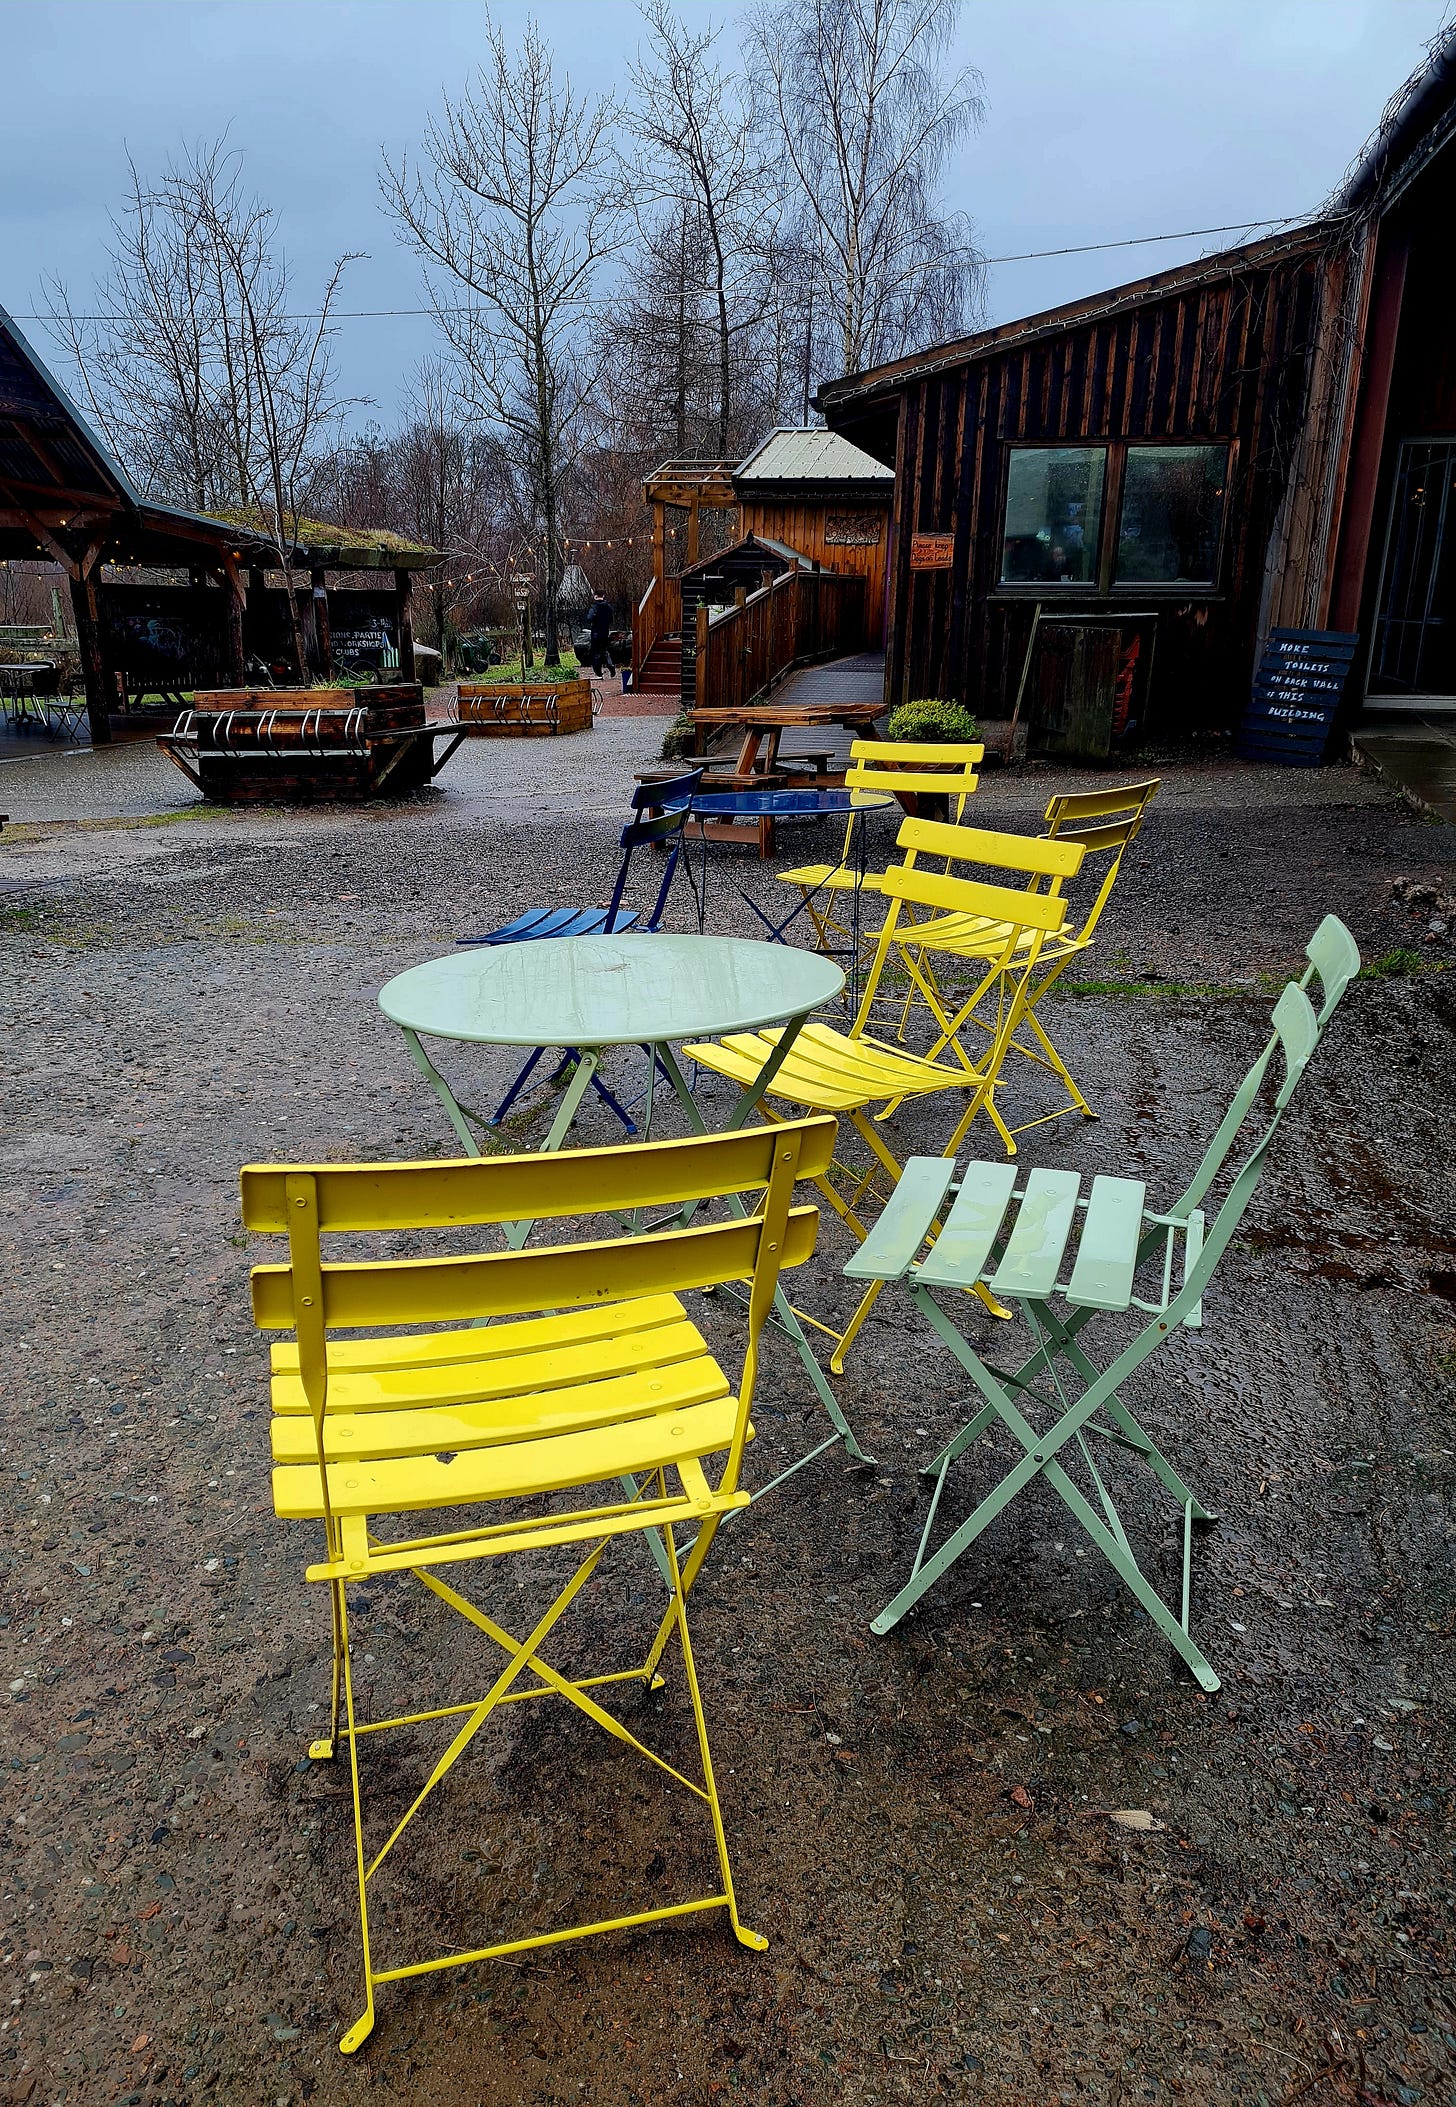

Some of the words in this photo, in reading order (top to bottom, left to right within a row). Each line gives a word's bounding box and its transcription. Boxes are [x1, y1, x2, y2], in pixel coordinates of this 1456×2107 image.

[935, 540, 949, 551] keep
[1279, 643, 1310, 654] MORE
[1284, 661, 1330, 673] TOILETS
[1270, 675, 1282, 683] ON
[1284, 677, 1308, 688] BACK
[1313, 680, 1339, 690] WALL
[1278, 691, 1305, 702] THIS
[1267, 706, 1325, 722] BUILDING
